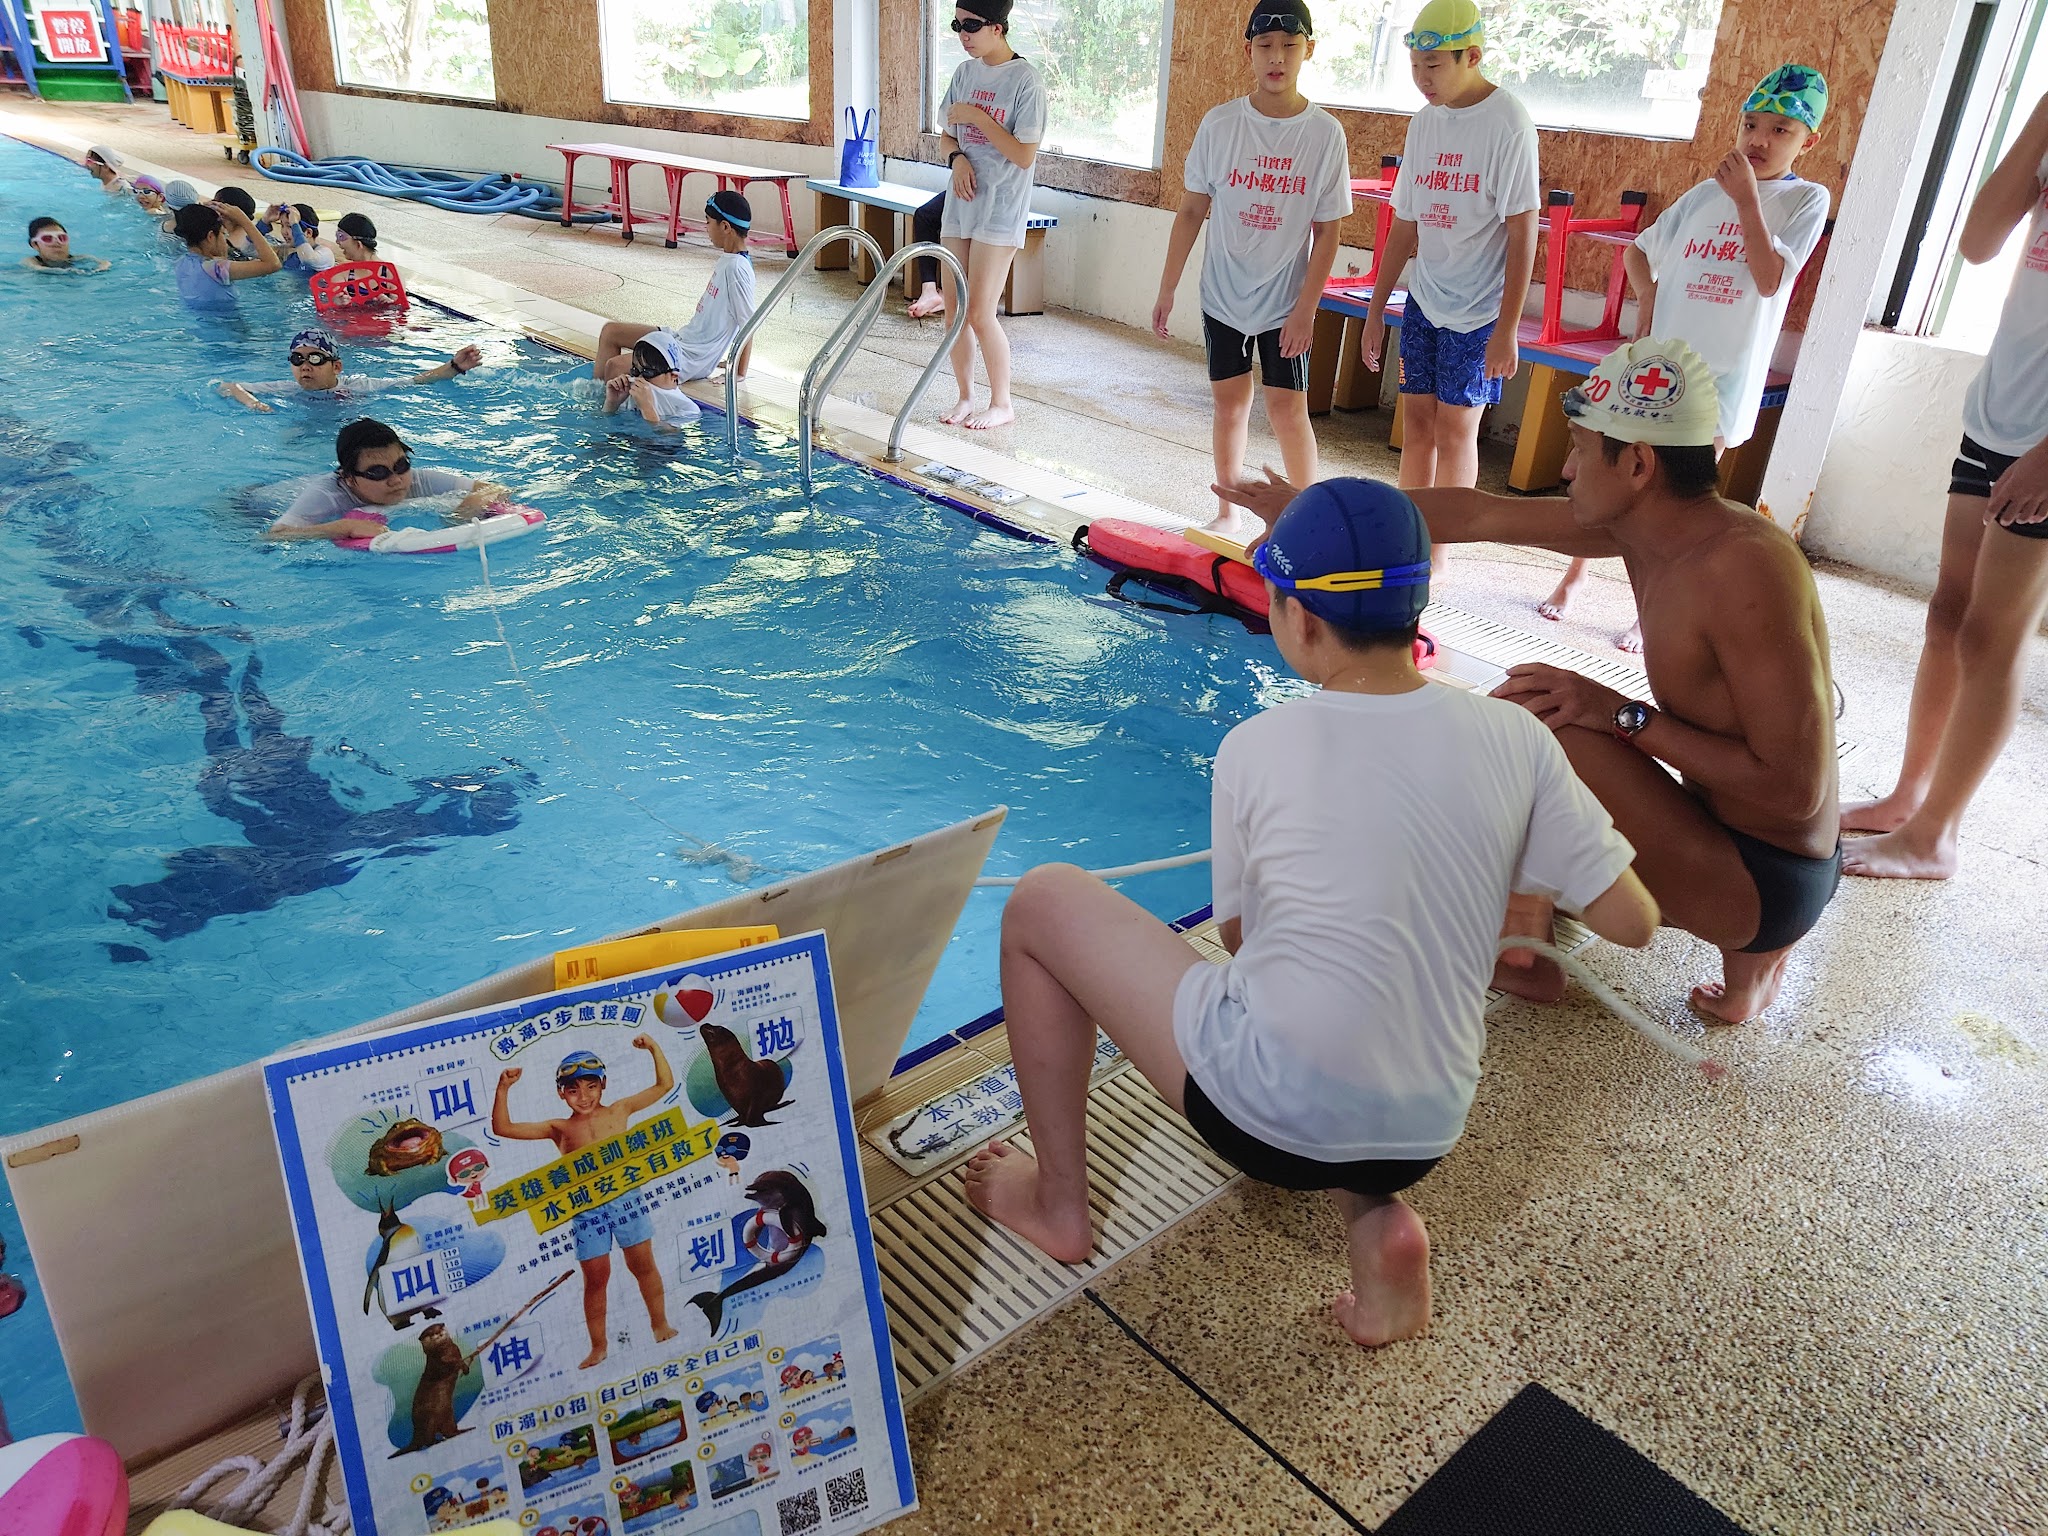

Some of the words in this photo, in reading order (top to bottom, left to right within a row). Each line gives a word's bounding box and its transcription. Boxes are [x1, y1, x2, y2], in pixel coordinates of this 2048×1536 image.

[50, 16, 87, 35] 暫停
[56, 36, 93, 54] 開放
[1246, 154, 1293, 171] 一日實習
[1227, 168, 1307, 196] 小小救生員
[1584, 374, 1612, 403] 20
[496, 1004, 642, 1055] 救溺5步應援團
[428, 1078, 476, 1122] 叫
[491, 1116, 678, 1215] 英雄養成訓練班
[540, 1127, 714, 1223] 水域安全有救了
[442, 1247, 459, 1258] 119
[444, 1258, 461, 1269] 118
[687, 1228, 726, 1273] 划
[391, 1258, 441, 1304] 叫
[446, 1270, 463, 1280] 110
[449, 1281, 464, 1291] 112
[487, 1336, 533, 1377] 伸
[494, 1396, 587, 1440] 防溺10招
[600, 1332, 763, 1405] 自己的安全自己顧
